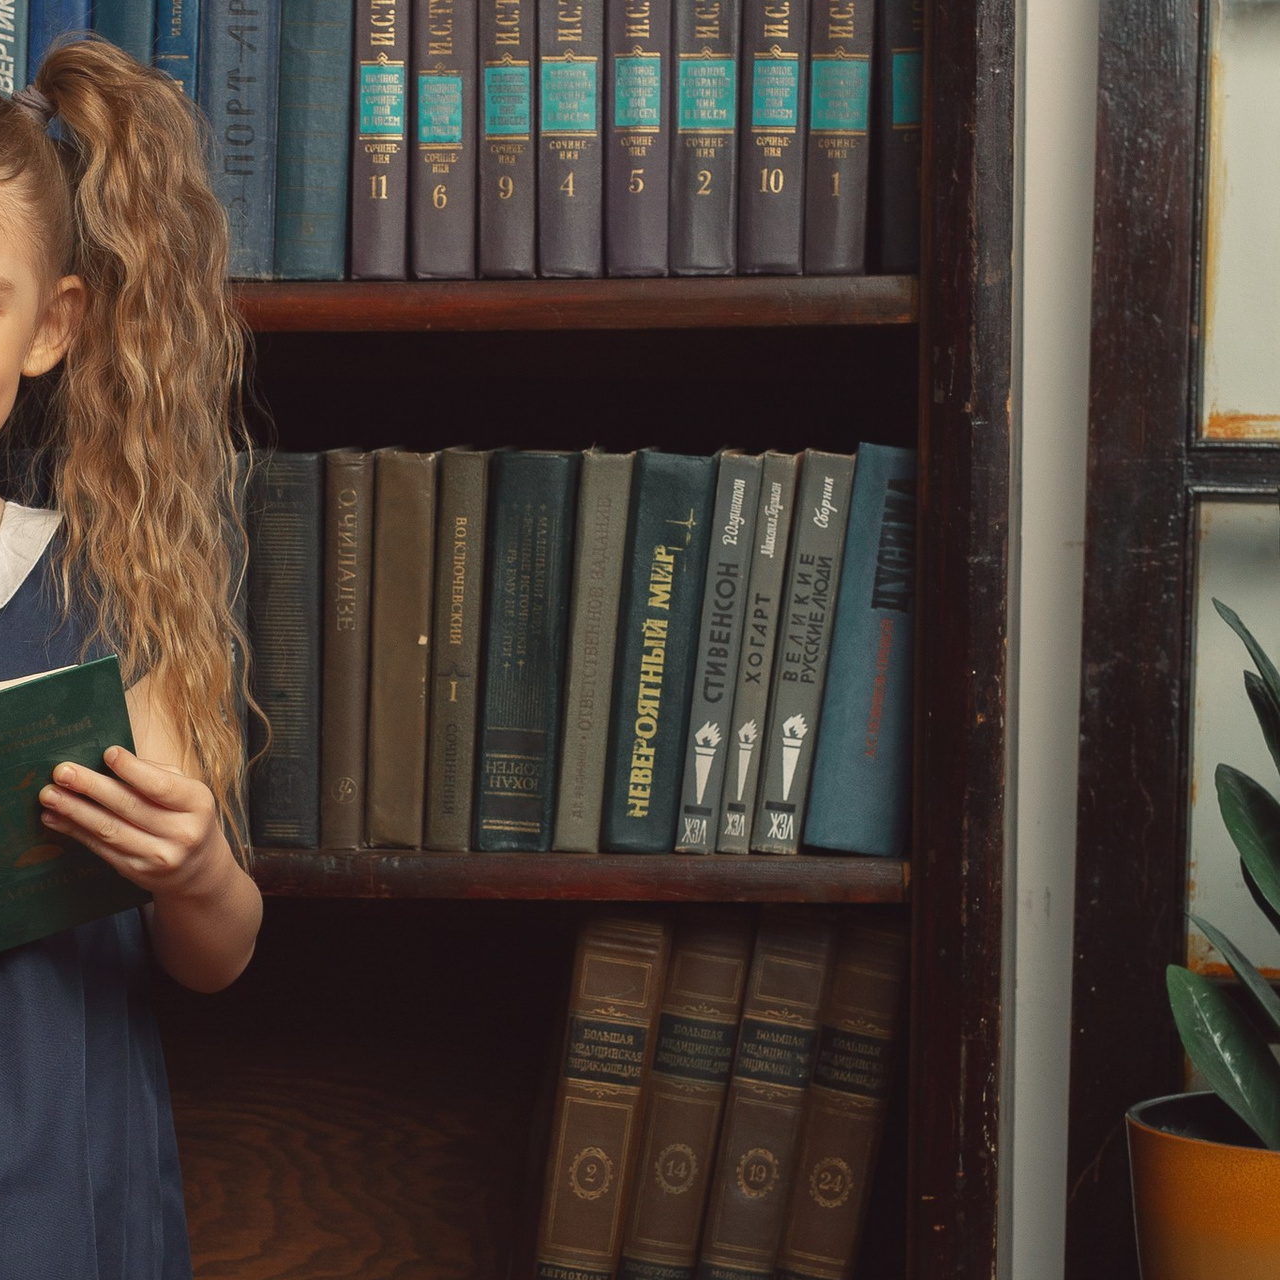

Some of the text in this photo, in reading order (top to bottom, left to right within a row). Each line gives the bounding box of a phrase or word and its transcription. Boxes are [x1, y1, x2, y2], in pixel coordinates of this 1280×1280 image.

[224, 67, 257, 176] ПОРТ
[369, 174, 388, 200] 11
[498, 175, 514, 199] 9
[559, 172, 576, 198] 4
[628, 168, 645, 194] 5
[696, 170, 712, 196] 2
[759, 168, 784, 194] 10
[831, 172, 841, 197] 1
[432, 184, 447, 210] 6
[813, 476, 836, 528] Сборник
[335, 513, 357, 632] ЧИЛАДЗЕ
[783, 552, 815, 684] ВЕЛИКИЕ
[800, 554, 834, 685] РУССКИЕ ЛЮДИ
[702, 561, 741, 704] СТИВЕНСОН
[744, 592, 772, 685] ХОГАРТ
[625, 544, 676, 820] НЕВЕРОЯТНЫЙ МИР
[443, 723, 458, 816] СОЧИНЕНИЯ
[682, 818, 707, 845] ЖЗЛ
[724, 813, 745, 837] ЖЗЛ
[767, 812, 794, 840] ЖЗЛ
[583, 1028, 635, 1045] БОЛЬШАЯ
[586, 1163, 597, 1183] 2
[666, 1159, 687, 1178] 14
[748, 1163, 767, 1183] 19
[819, 1172, 842, 1192] 24
